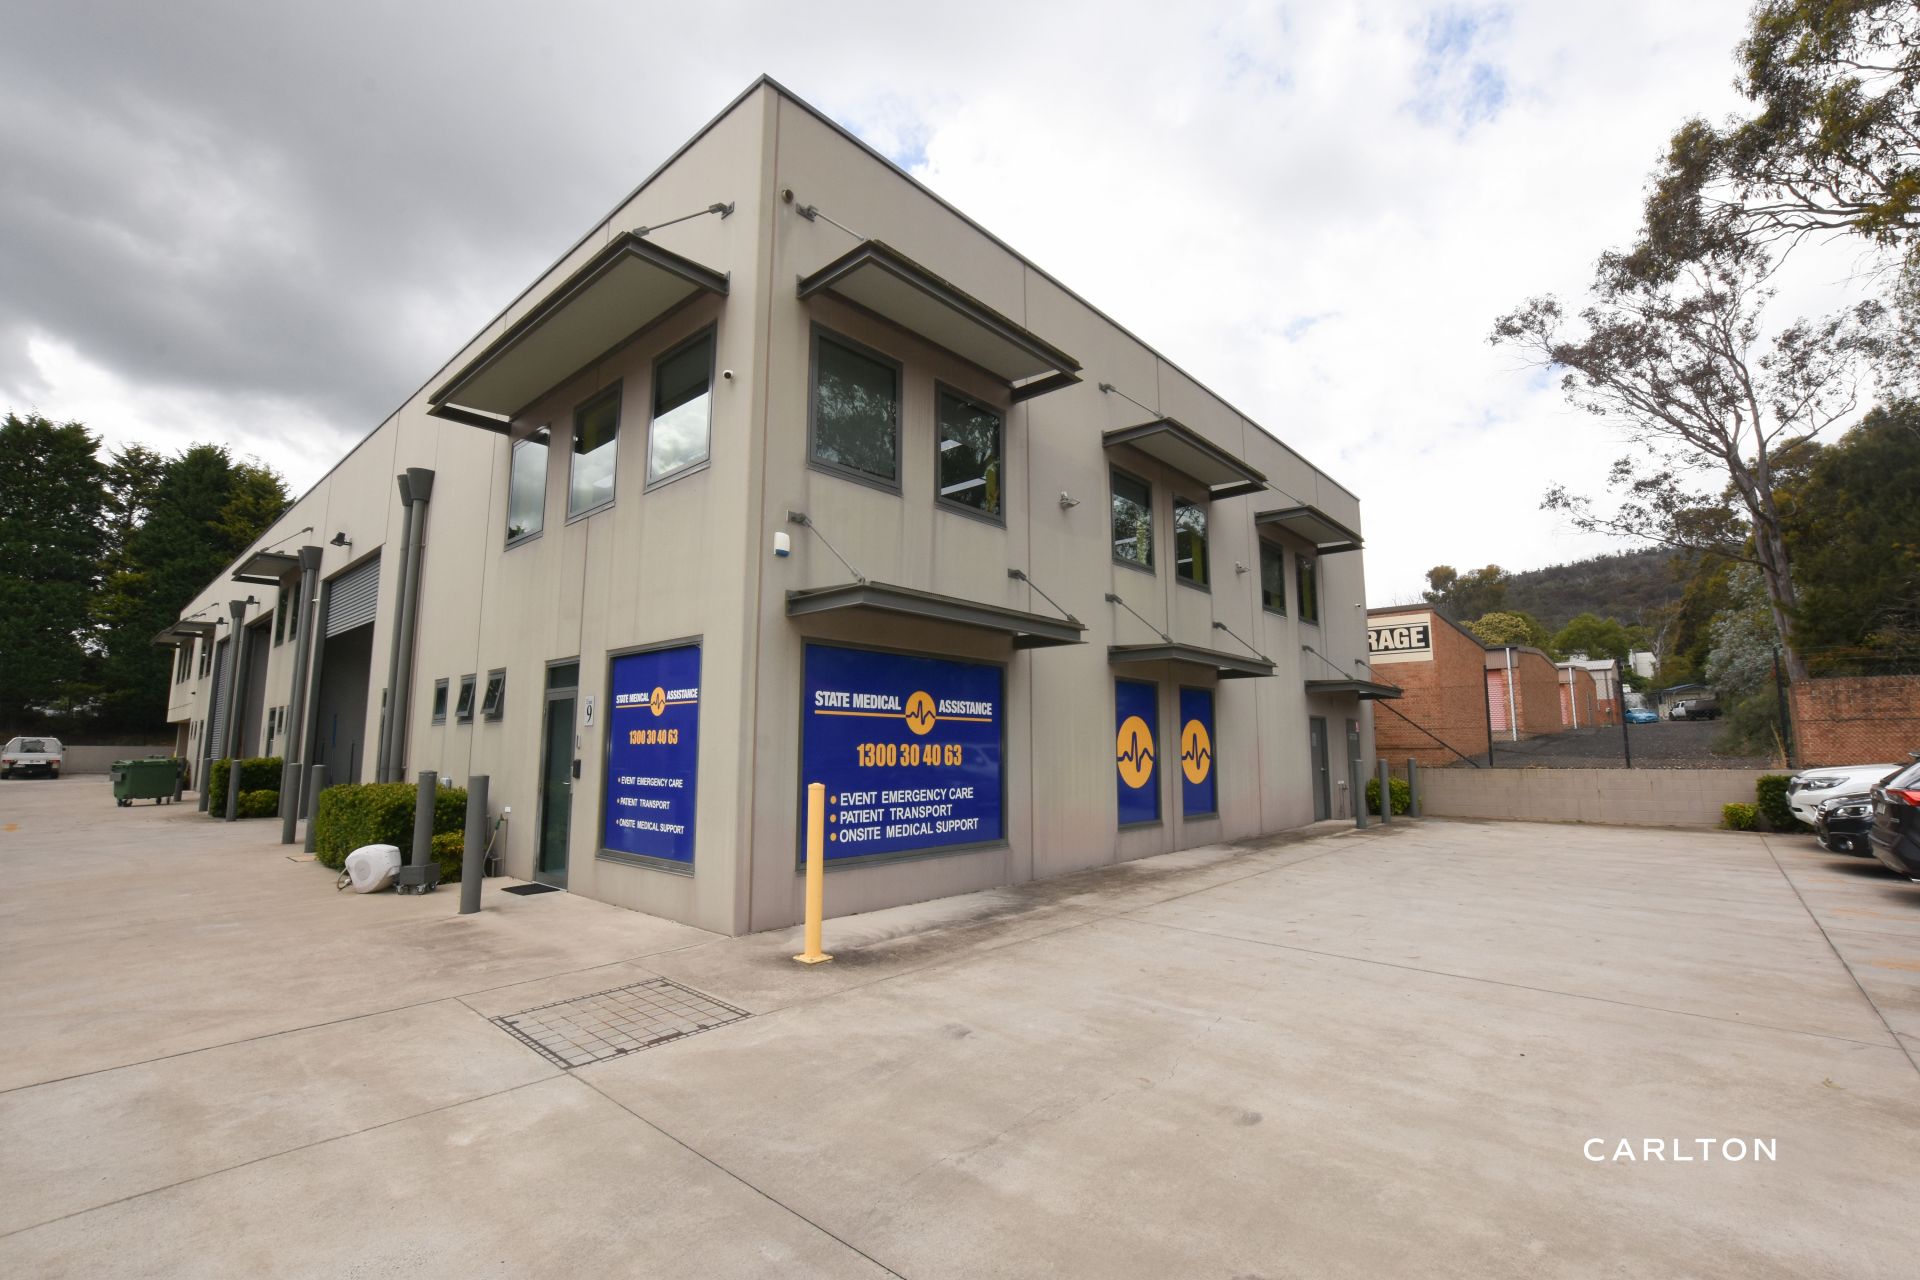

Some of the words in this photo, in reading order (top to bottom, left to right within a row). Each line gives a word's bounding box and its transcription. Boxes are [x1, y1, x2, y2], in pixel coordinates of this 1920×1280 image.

[616, 694, 629, 704] STATE
[629, 692, 649, 703] MEDICAL
[666, 688, 698, 700] ASSISTANCE
[815, 690, 850, 707] STATE
[852, 693, 902, 711] MEDICAL
[938, 699, 993, 716] ASSISTANCE
[586, 704, 593, 722] 9
[629, 730, 646, 745] 1300
[646, 729, 657, 745] 30
[657, 729, 667, 745] 40
[667, 729, 678, 745] 63
[856, 743, 897, 767] 1300
[900, 744, 920, 767] 30
[922, 744, 941, 766] 40
[944, 744, 962, 766] 63
[621, 776, 636, 785] EVENT
[637, 777, 668, 787] EMERGENCY
[668, 778, 683, 788] CARE
[620, 797, 638, 807] PATIENT
[639, 798, 670, 810] TRANSPORT
[840, 791, 877, 806] EVENT
[881, 788, 947, 804] EMERGENCY
[949, 787, 974, 799] CARE
[840, 808, 885, 824] PATIENT
[890, 804, 953, 821] TRANSPORT
[619, 818, 636, 828] ONSITE
[636, 820, 659, 831] MEDICAL
[659, 823, 685, 835] SUPPORT
[839, 826, 881, 843] ONSITE
[886, 822, 934, 838] MEDICAL
[935, 817, 979, 833] SUPPORT
